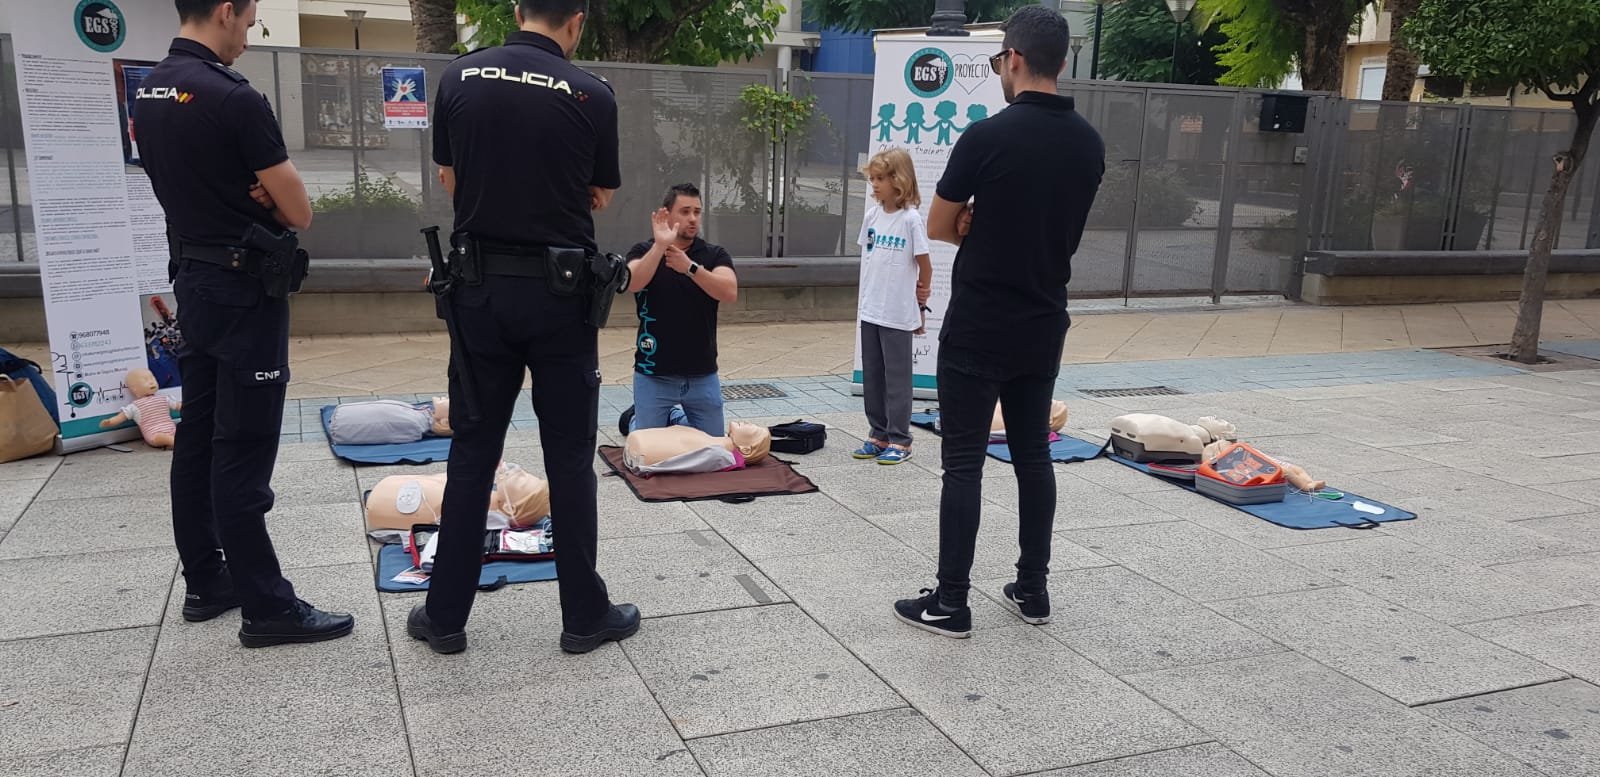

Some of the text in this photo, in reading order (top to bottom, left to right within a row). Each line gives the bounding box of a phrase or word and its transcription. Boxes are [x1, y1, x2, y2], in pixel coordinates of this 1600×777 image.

[85, 16, 110, 34] EGS
[914, 66, 937, 81] EGS
[955, 63, 990, 79] PROYECTO
[460, 66, 573, 95] POLICIA
[135, 87, 179, 100] OLICIA
[255, 370, 280, 380] CNP
